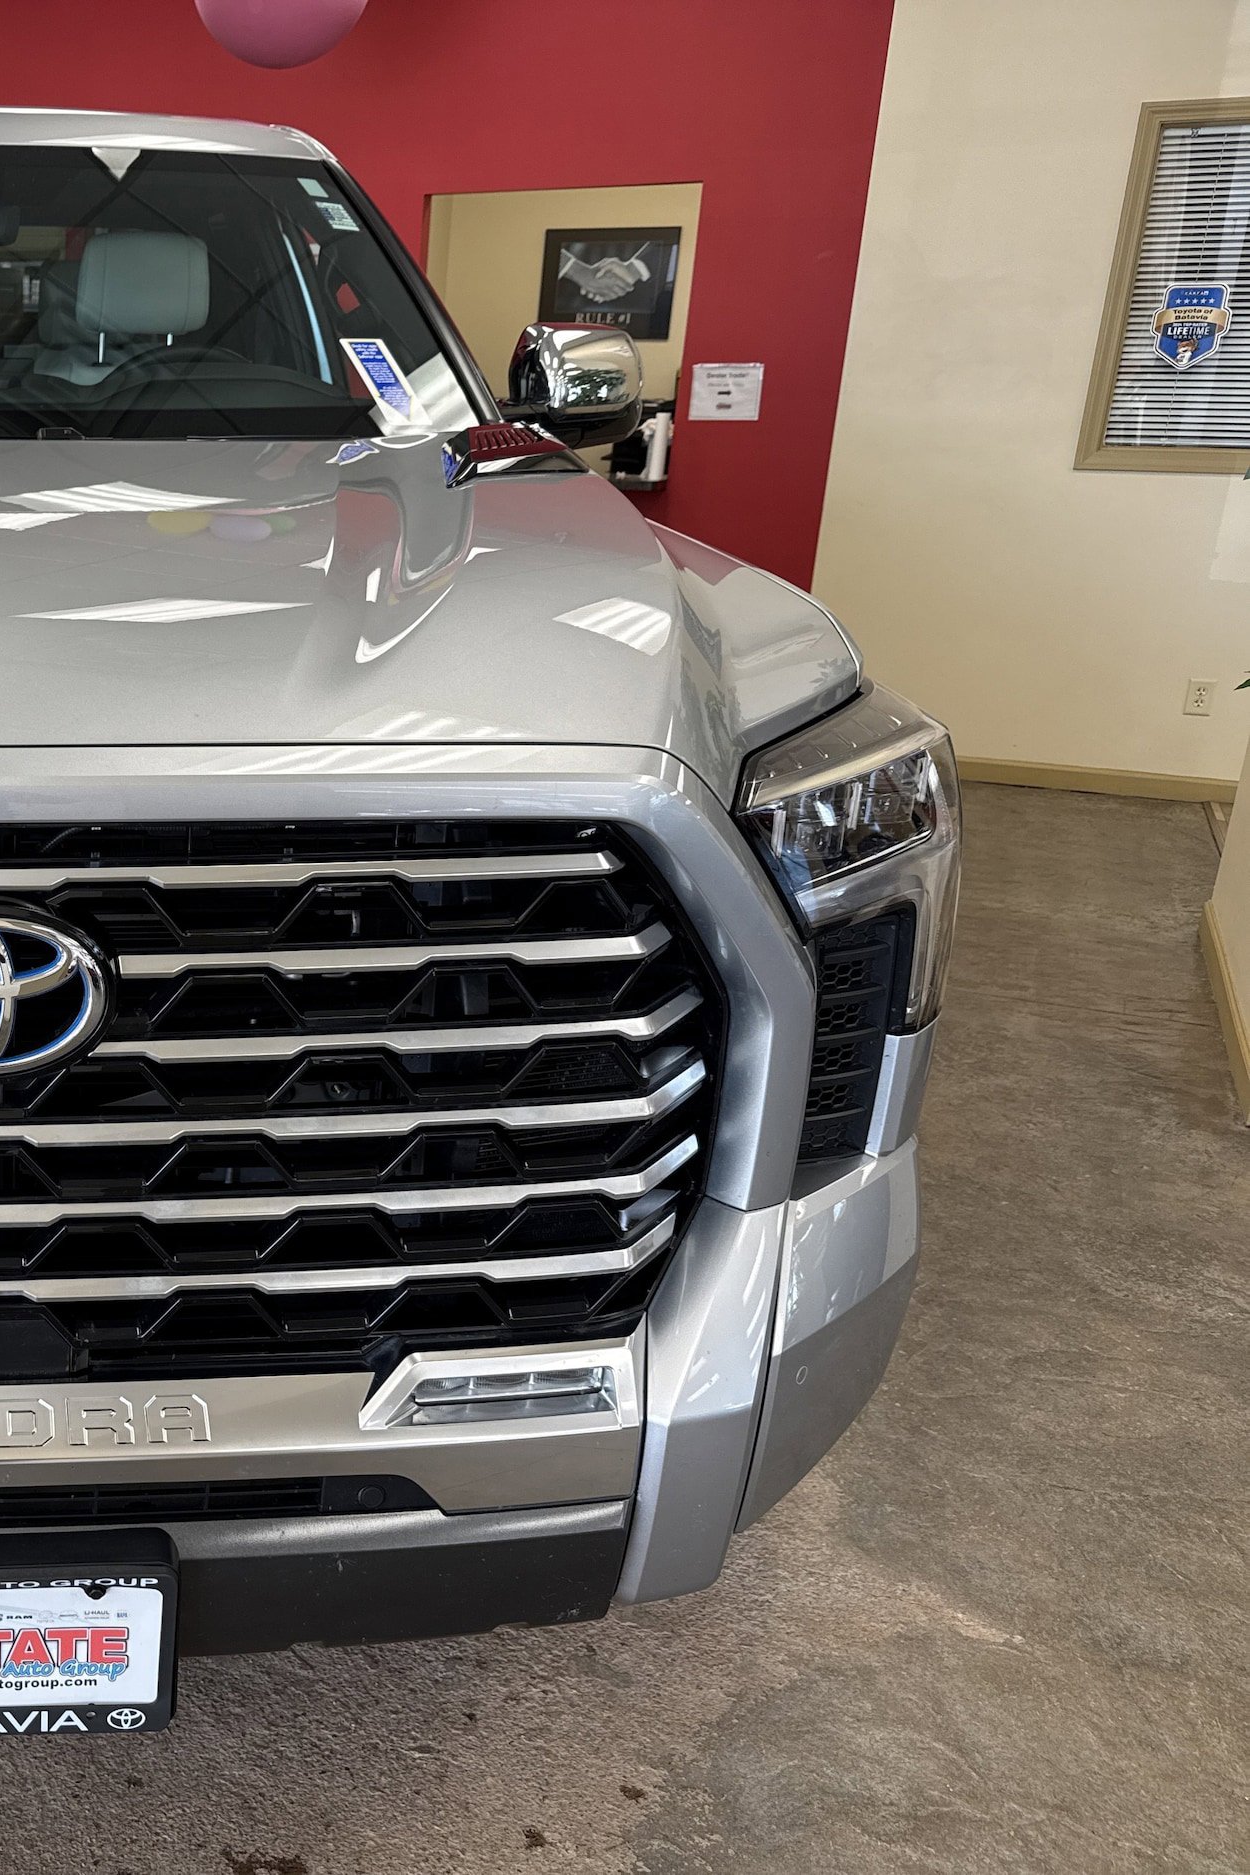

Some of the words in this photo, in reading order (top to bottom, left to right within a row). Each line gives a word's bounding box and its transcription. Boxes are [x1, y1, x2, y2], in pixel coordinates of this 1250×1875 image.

[575, 312, 616, 324] RULE
[618, 312, 631, 325] #1
[1167, 327, 1210, 335] LIFETIME
[49, 1577, 159, 1588] GROUP
[0, 1659, 54, 1678] Auto
[57, 1658, 128, 1682] Group
